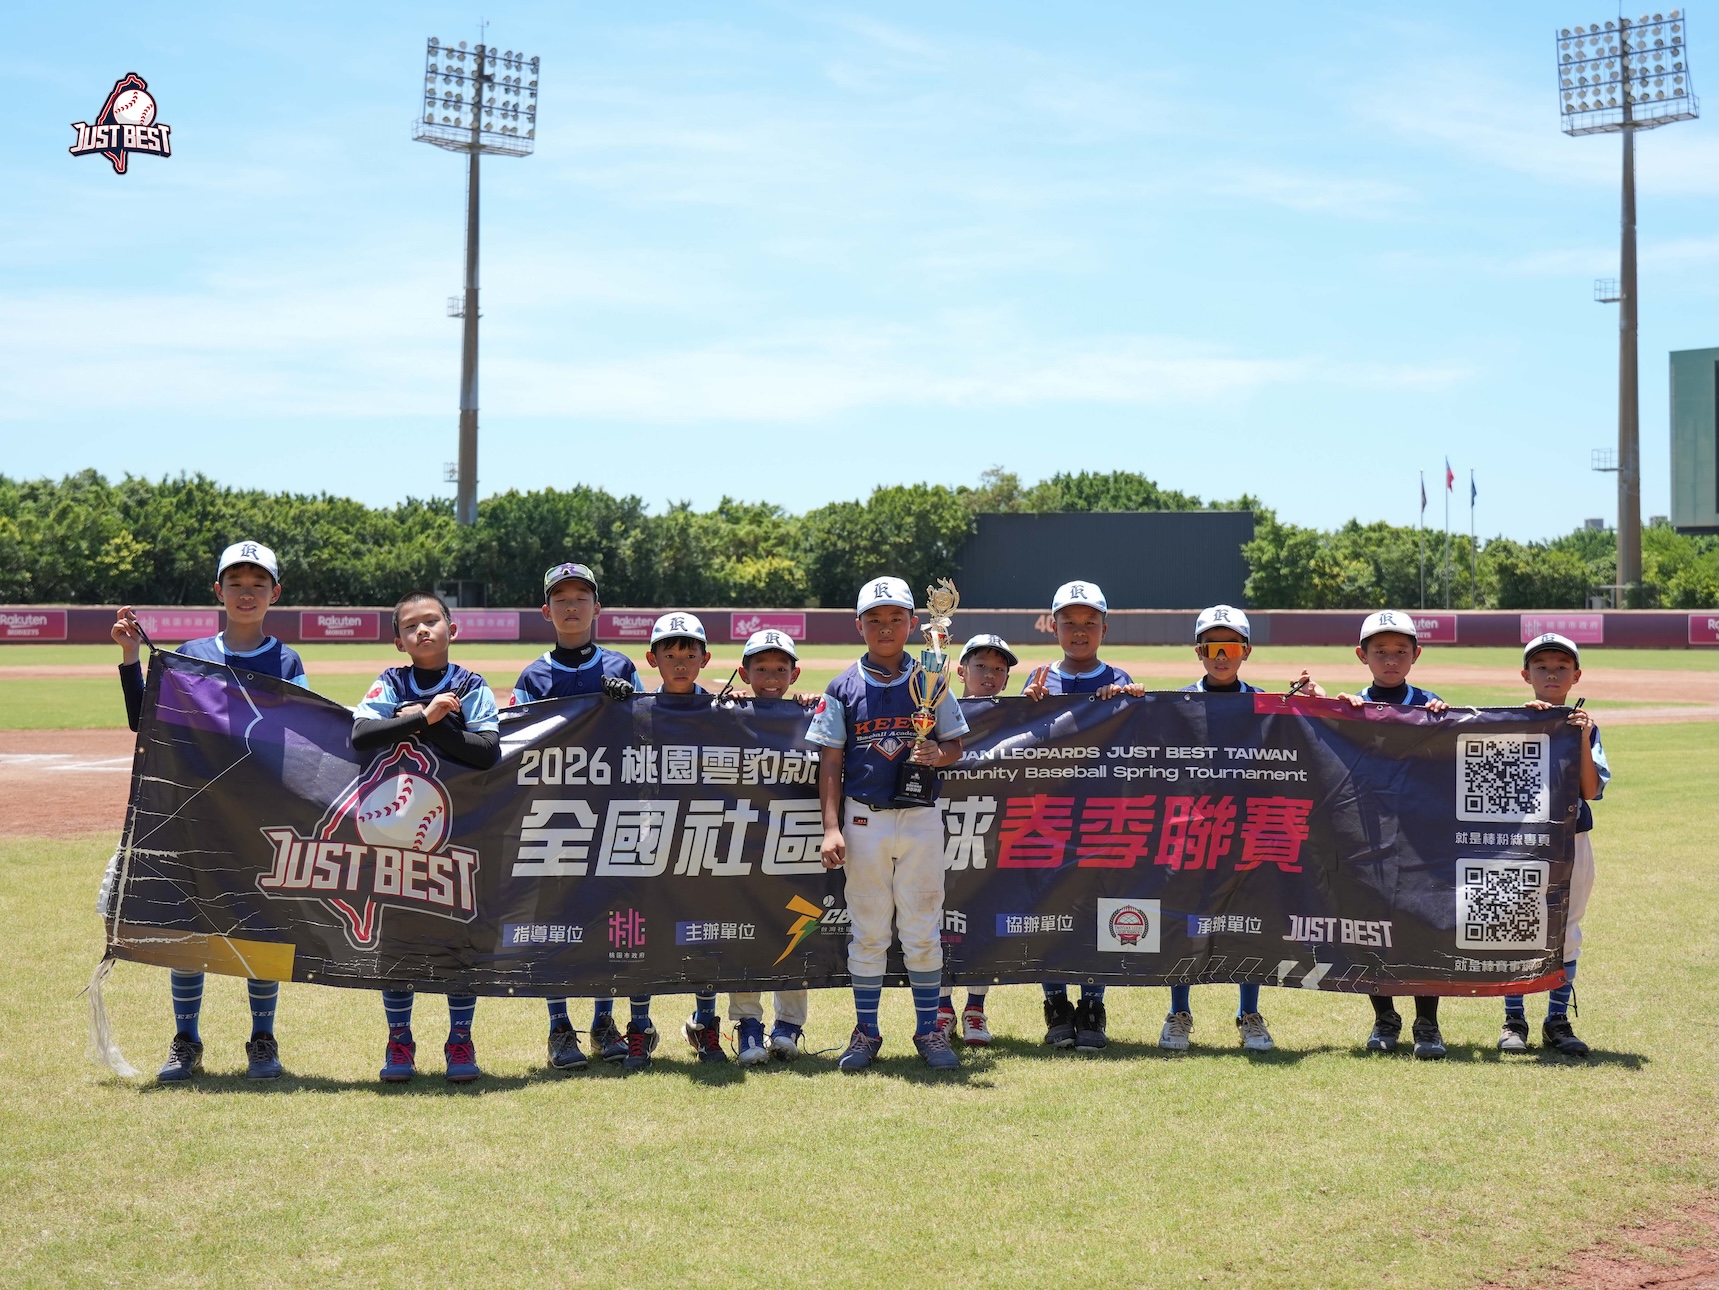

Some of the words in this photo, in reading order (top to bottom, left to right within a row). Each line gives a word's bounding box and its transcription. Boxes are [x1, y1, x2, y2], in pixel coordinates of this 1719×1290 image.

[0, 613, 48, 625] Rakuten
[317, 615, 362, 626] Rakuten
[612, 615, 654, 627] Rakuten
[854, 716, 915, 735] KEE
[856, 731, 887, 742] Baseball
[1000, 747, 1101, 760] LEOPARDS
[1107, 746, 1161, 760] JUST
[1166, 746, 1218, 760] BEST
[1224, 747, 1298, 761] TAIWAN
[517, 746, 611, 785] 2026
[621, 745, 820, 785] 桃園雲豹就
[1025, 765, 1107, 779] Baseball
[1113, 764, 1179, 782] Spring
[1185, 765, 1308, 782] Tournament
[260, 831, 368, 891] JUST
[373, 847, 475, 911] BEST
[940, 909, 967, 934] 市
[1006, 915, 1074, 933] 協辦單位
[1197, 915, 1262, 934] 承辦單位
[513, 925, 584, 943] 指導單位
[686, 923, 756, 942] 主辦單位
[1282, 915, 1337, 942] JUST
[1340, 918, 1393, 948] BEST
[609, 951, 645, 959] 桃園市政府
